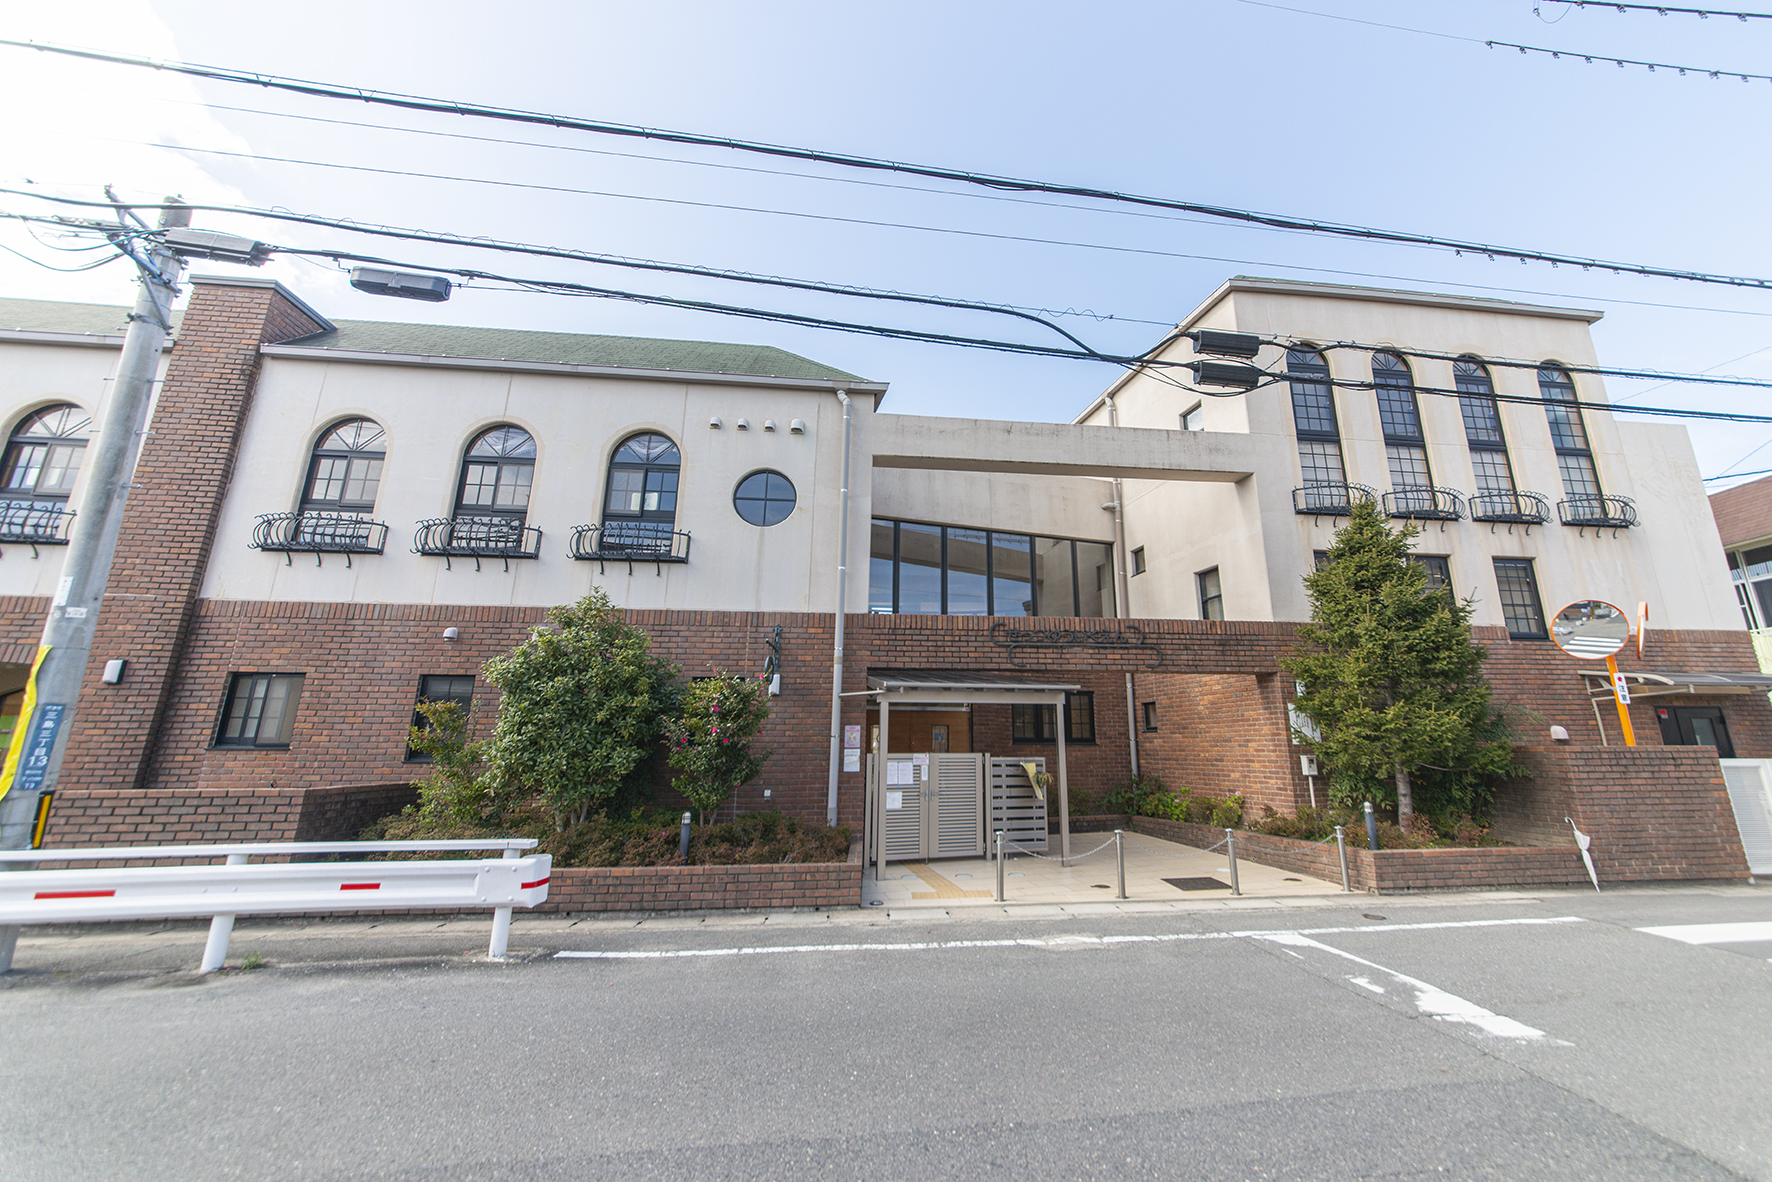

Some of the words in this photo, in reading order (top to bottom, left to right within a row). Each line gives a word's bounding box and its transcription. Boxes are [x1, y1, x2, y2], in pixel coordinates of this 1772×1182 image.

[1006, 628, 1128, 643] せっつゆういくえん
[27, 756, 49, 767] 13
